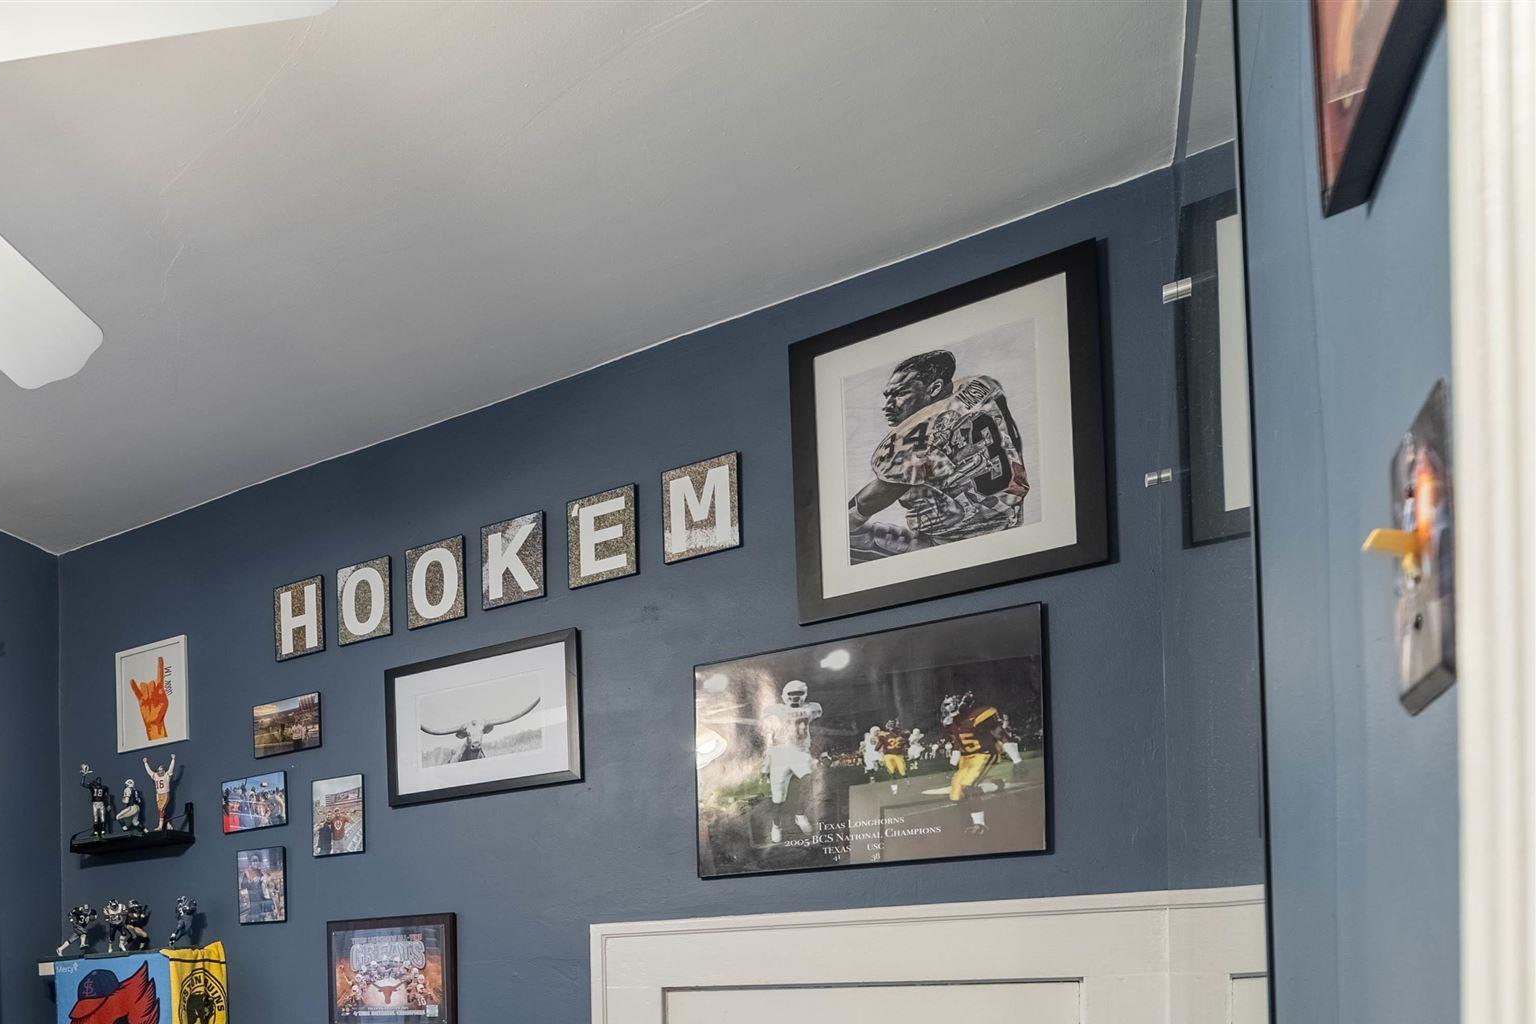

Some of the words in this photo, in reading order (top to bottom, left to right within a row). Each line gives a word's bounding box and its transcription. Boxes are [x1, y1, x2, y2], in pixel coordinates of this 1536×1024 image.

[280, 522, 539, 656] HOOK
[959, 733, 981, 752] 5
[156, 780, 164, 789] 16
[93, 788, 103, 797] 18
[818, 821, 846, 831] TEXAS
[848, 816, 905, 828] LONGHORNS
[784, 838, 810, 847] 2005
[812, 833, 833, 845] BCS
[836, 831, 883, 841] NATIONAL
[885, 825, 942, 837] CHAMPIONS
[822, 845, 852, 854] TEXAS
[866, 842, 885, 851] USC
